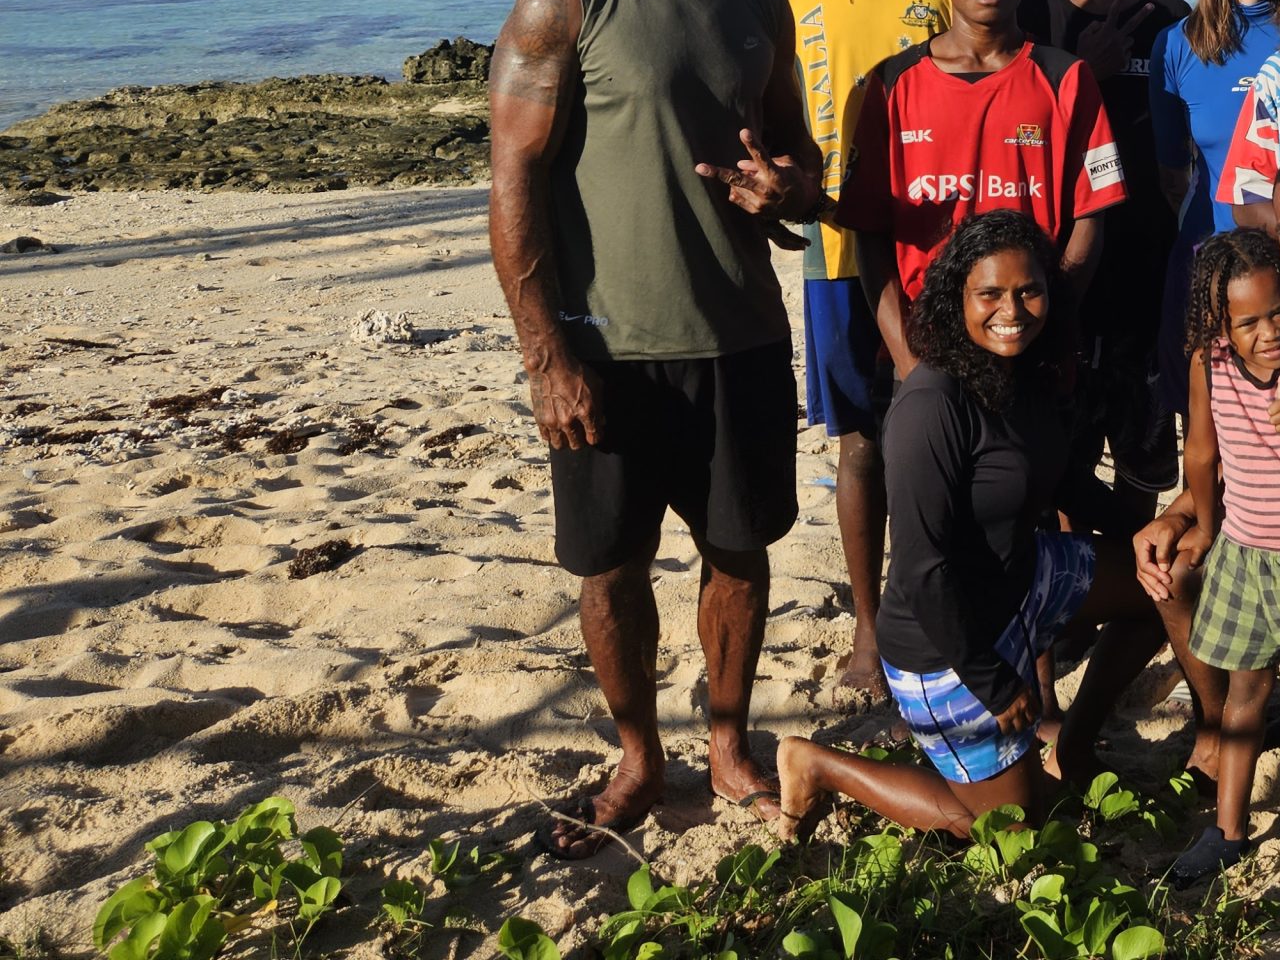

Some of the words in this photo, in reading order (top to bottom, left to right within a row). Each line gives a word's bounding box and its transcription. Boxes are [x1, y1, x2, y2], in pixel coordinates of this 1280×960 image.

[799, 3, 842, 193] USTRALIA
[901, 129, 934, 144] BLK
[921, 174, 975, 202] SBS
[988, 175, 1043, 199] Bank
[584, 315, 609, 327] PRO
